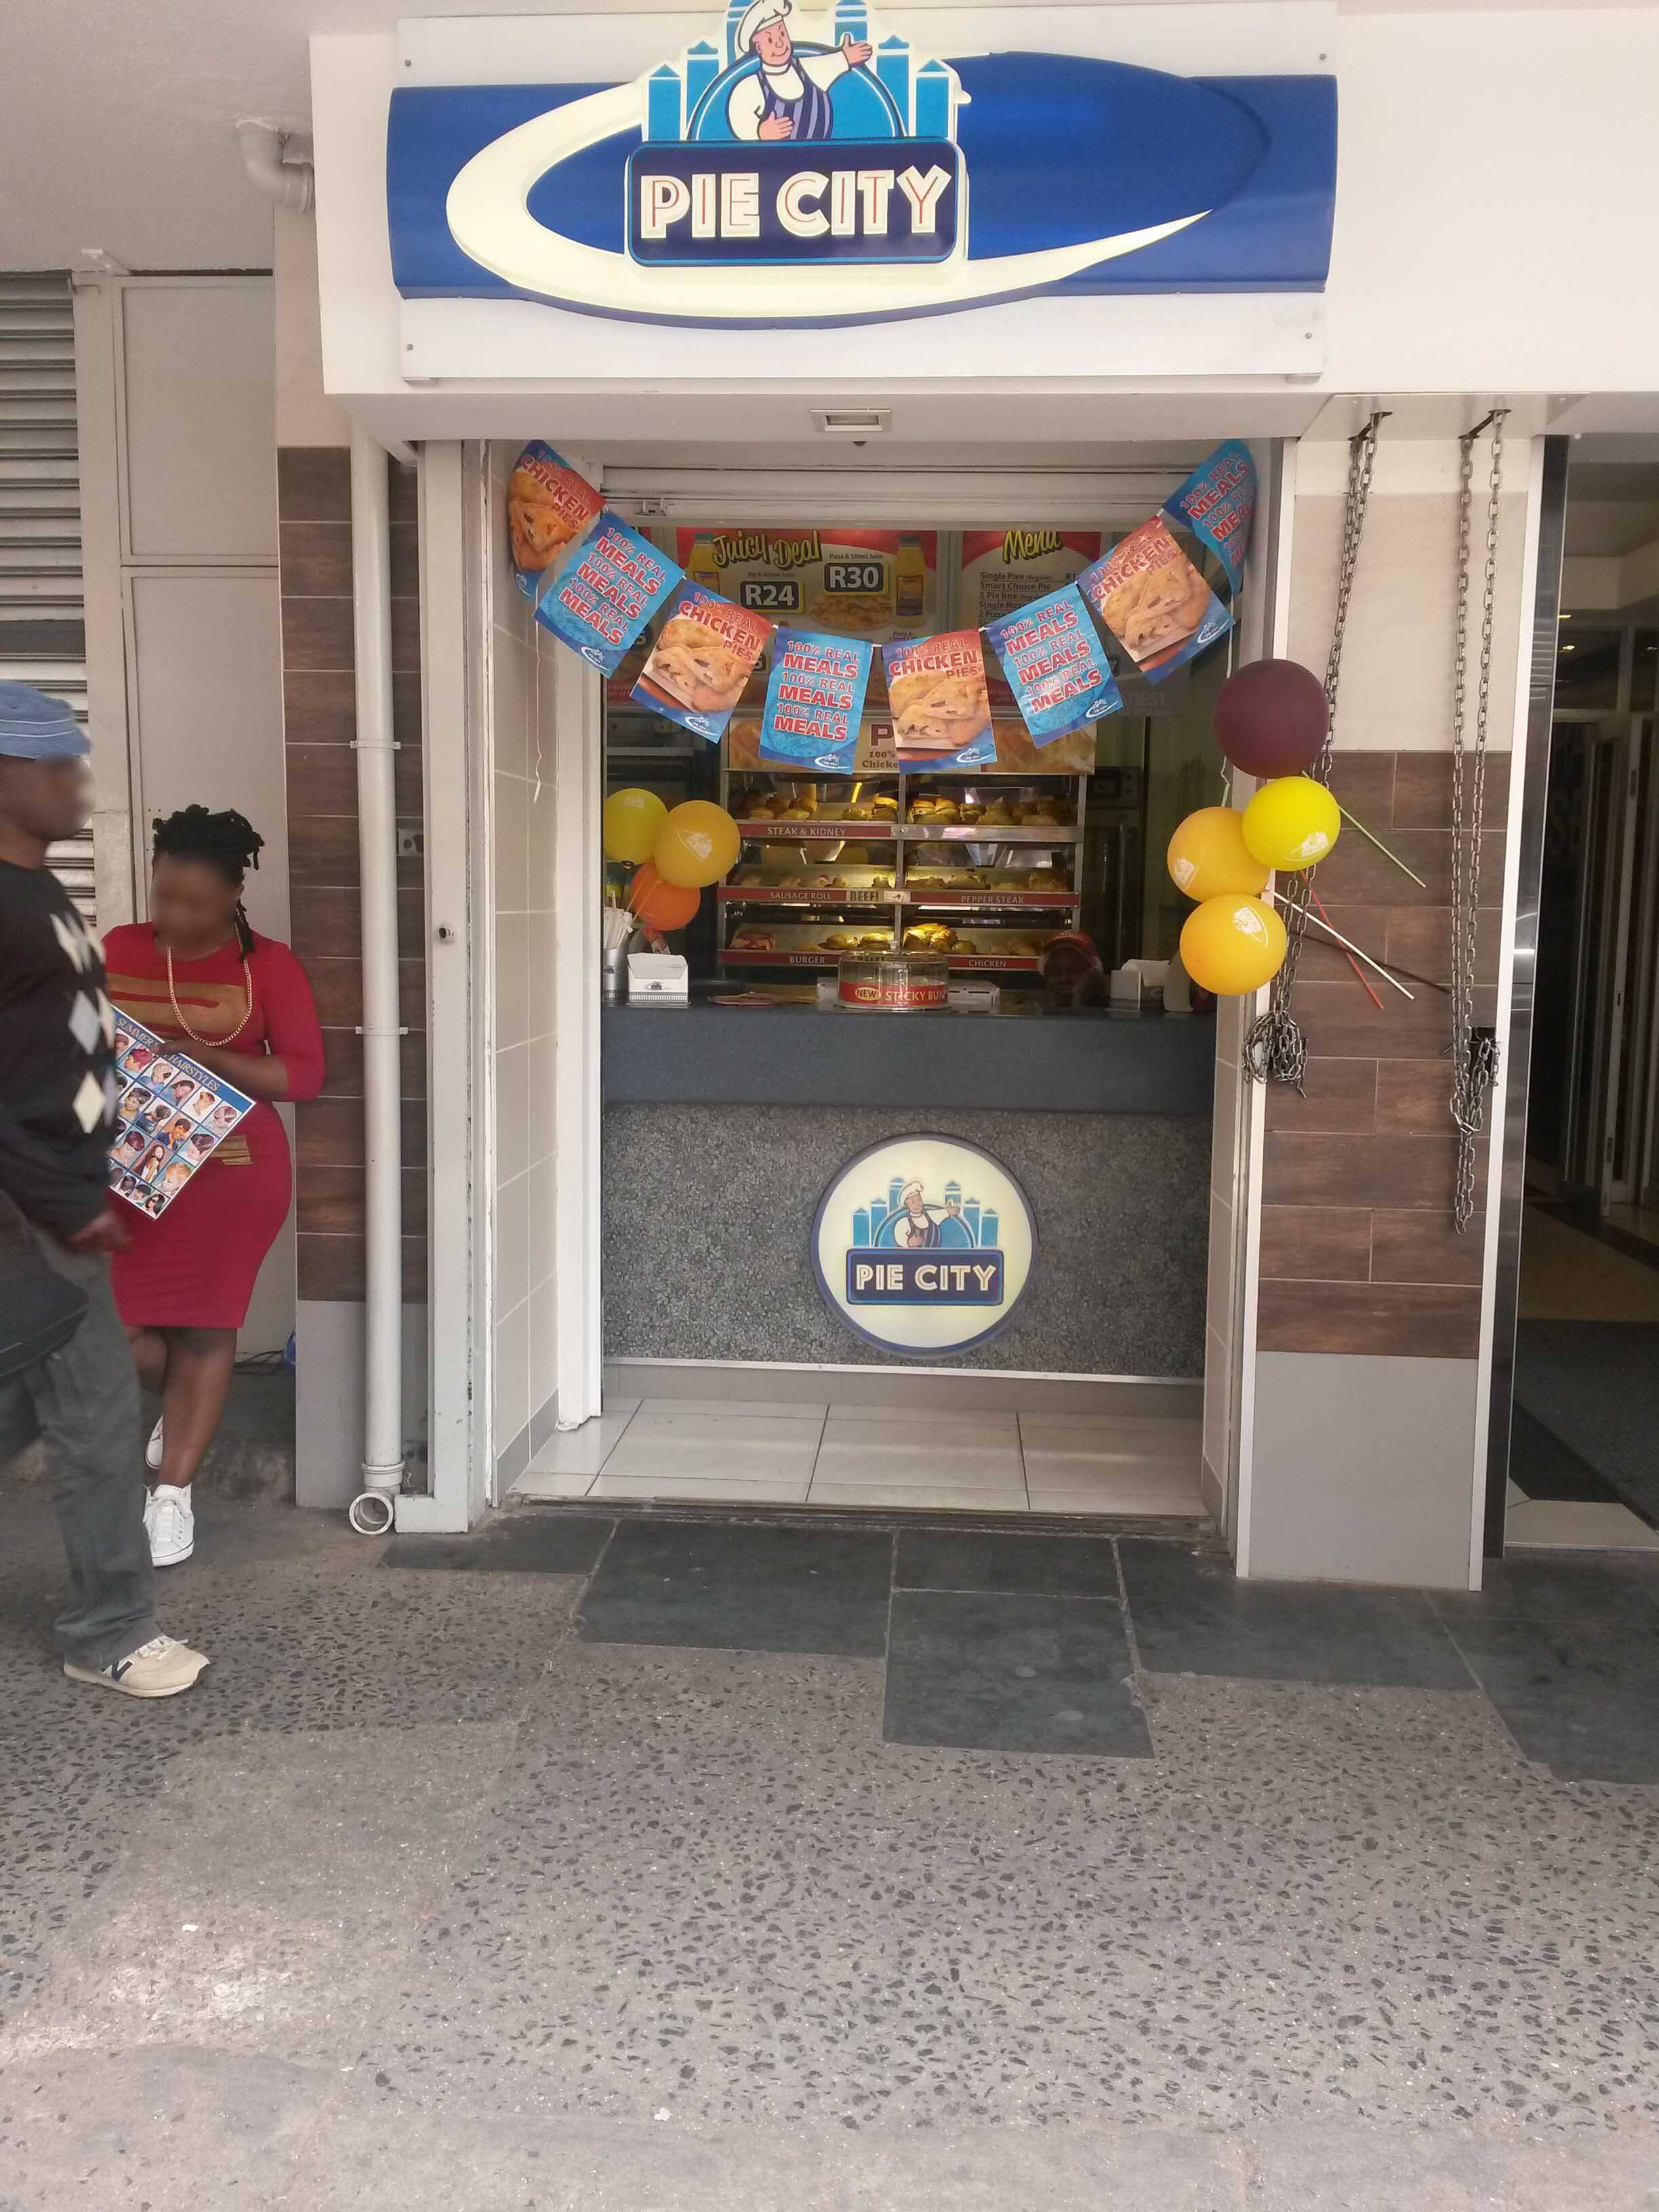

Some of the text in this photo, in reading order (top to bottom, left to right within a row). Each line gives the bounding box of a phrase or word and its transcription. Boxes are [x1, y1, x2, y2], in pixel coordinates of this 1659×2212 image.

[641, 164, 952, 239] PIE CITY
[522, 455, 591, 521] CHICKEN
[1180, 451, 1240, 510] 100% REAL
[1187, 459, 1248, 520] MEALS
[1202, 503, 1230, 529] 100%
[607, 527, 667, 583] 100% REAL
[712, 529, 823, 571] Juicy Deal
[1003, 531, 1063, 564] Menu
[595, 536, 661, 595] MEALS
[830, 566, 880, 589] R30
[981, 571, 1006, 581] Single
[1092, 534, 1172, 600] CHICKEN
[577, 562, 642, 619] MEALS
[588, 552, 648, 607] 100% REAL
[979, 581, 1004, 590] Smart
[1007, 581, 1036, 590] Choice
[570, 578, 630, 632] 100% REAL
[745, 583, 794, 607] R24
[558, 587, 624, 645] MEALS
[679, 600, 760, 651] CHICKEN
[726, 609, 757, 632] REAL
[1000, 600, 1073, 640] 100% REAL
[933, 638, 967, 653] REAL
[1004, 610, 1079, 656] MEALS
[722, 640, 754, 661] PIES
[787, 640, 860, 663] 100% REAL
[1013, 628, 1085, 668] 100% REAL
[1018, 639, 1091, 684] MEALS
[783, 652, 859, 680] MEALS
[889, 649, 978, 676] CHICKEN
[945, 665, 979, 680] PIES
[781, 671, 855, 694] 100% REAL
[1026, 674, 1058, 697] 100%
[1062, 657, 1098, 680] REAL
[778, 683, 853, 711] MEALS
[1030, 668, 1103, 714] MEALS
[774, 714, 848, 741] MEALS
[777, 702, 850, 726] 100% REAL
[861, 760, 899, 769] Chicke
[869, 750, 896, 758] 100%
[767, 827, 846, 836] STEAK & KIDNEY
[770, 892, 809, 900] SAUSAGE
[849, 890, 880, 902] BEEF!
[961, 895, 1025, 904] PEPPER STEAK
[789, 956, 825, 964] BURGER
[968, 960, 1007, 968] CHICKEN
[885, 990, 926, 1002] STICKY
[118, 1018, 219, 1091] SUMMER HAIRSTYLES
[856, 1264, 997, 1291] PIE CITY
